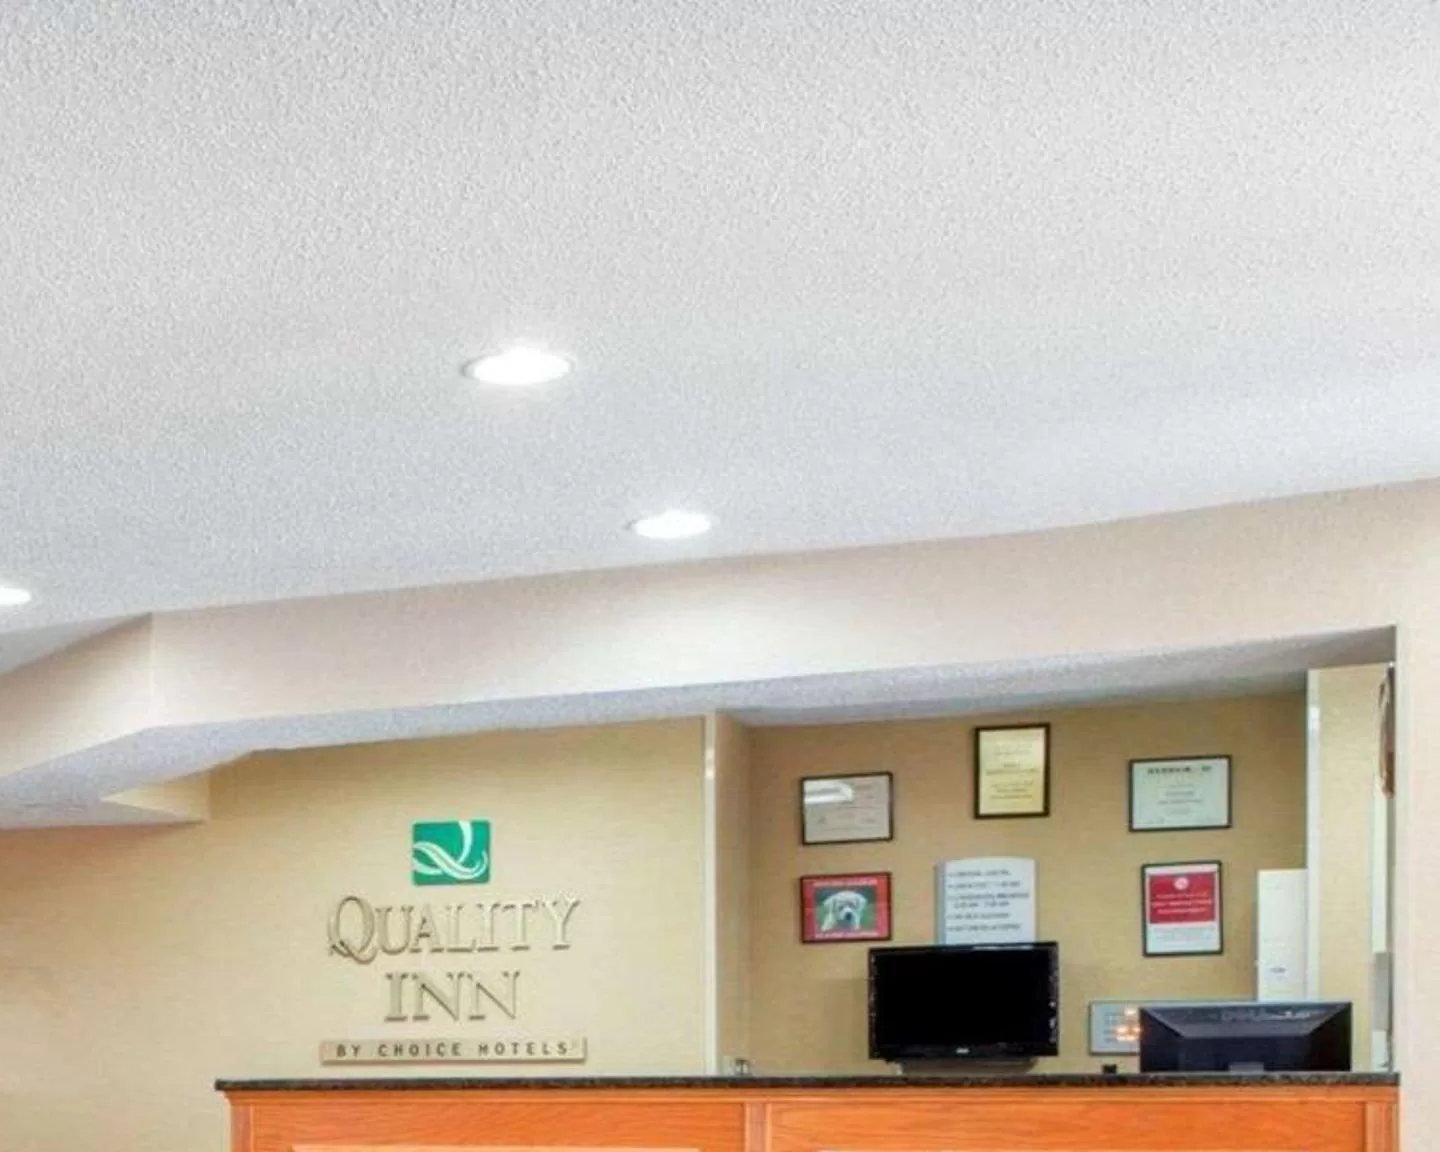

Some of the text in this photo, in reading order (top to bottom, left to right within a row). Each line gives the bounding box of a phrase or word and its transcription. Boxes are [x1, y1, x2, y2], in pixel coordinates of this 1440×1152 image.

[327, 895, 580, 964] QUALITY
[383, 969, 521, 1023] INN
[336, 1041, 569, 1058] BY CHOICE HOTELS
